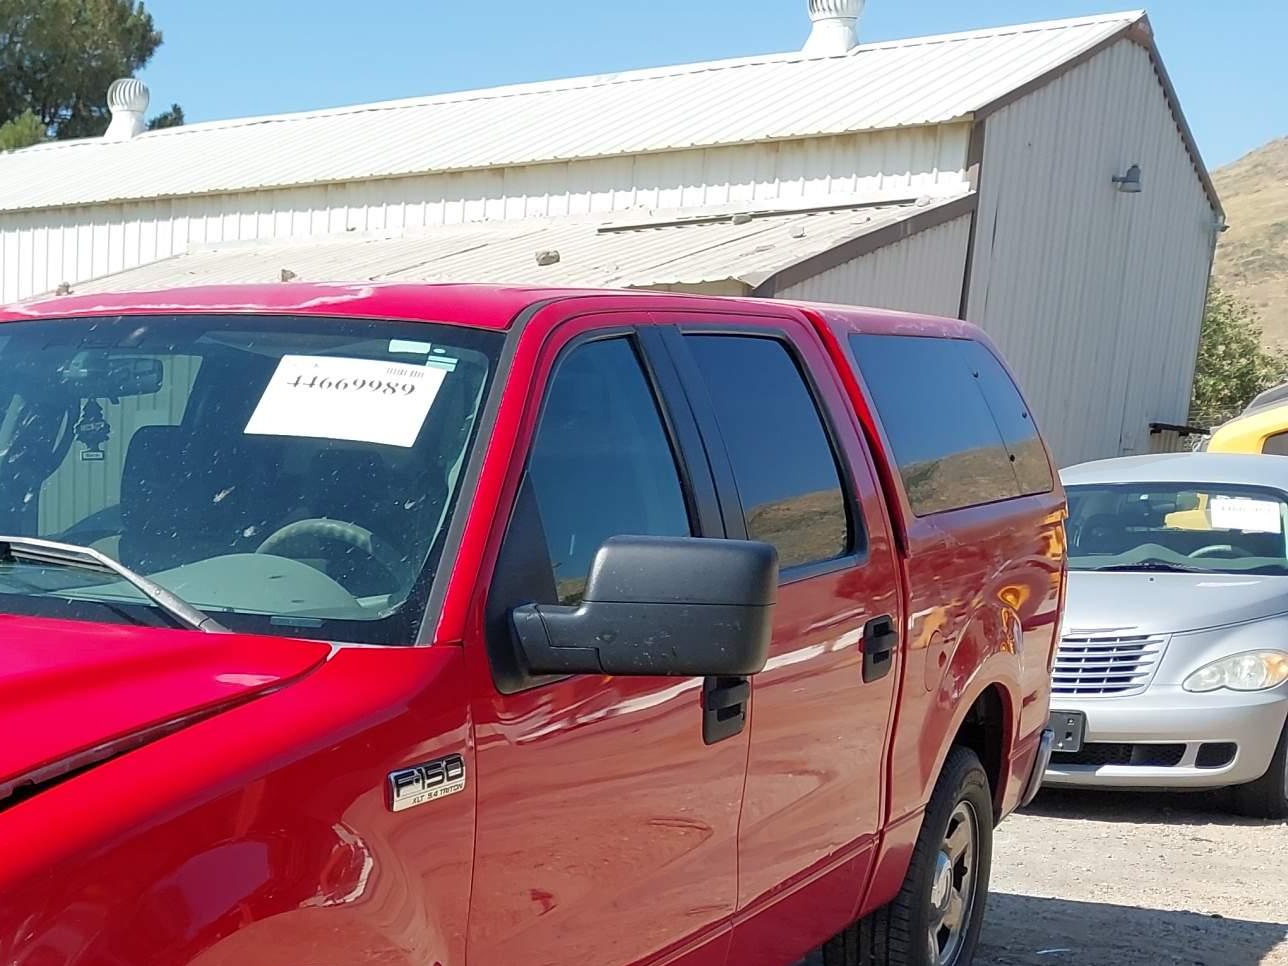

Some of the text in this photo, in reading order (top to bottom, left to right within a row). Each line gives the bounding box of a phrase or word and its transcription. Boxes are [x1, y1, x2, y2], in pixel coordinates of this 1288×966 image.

[286, 374, 416, 396] 44669989
[411, 795, 425, 805] XLT
[439, 783, 464, 796] TRITON
